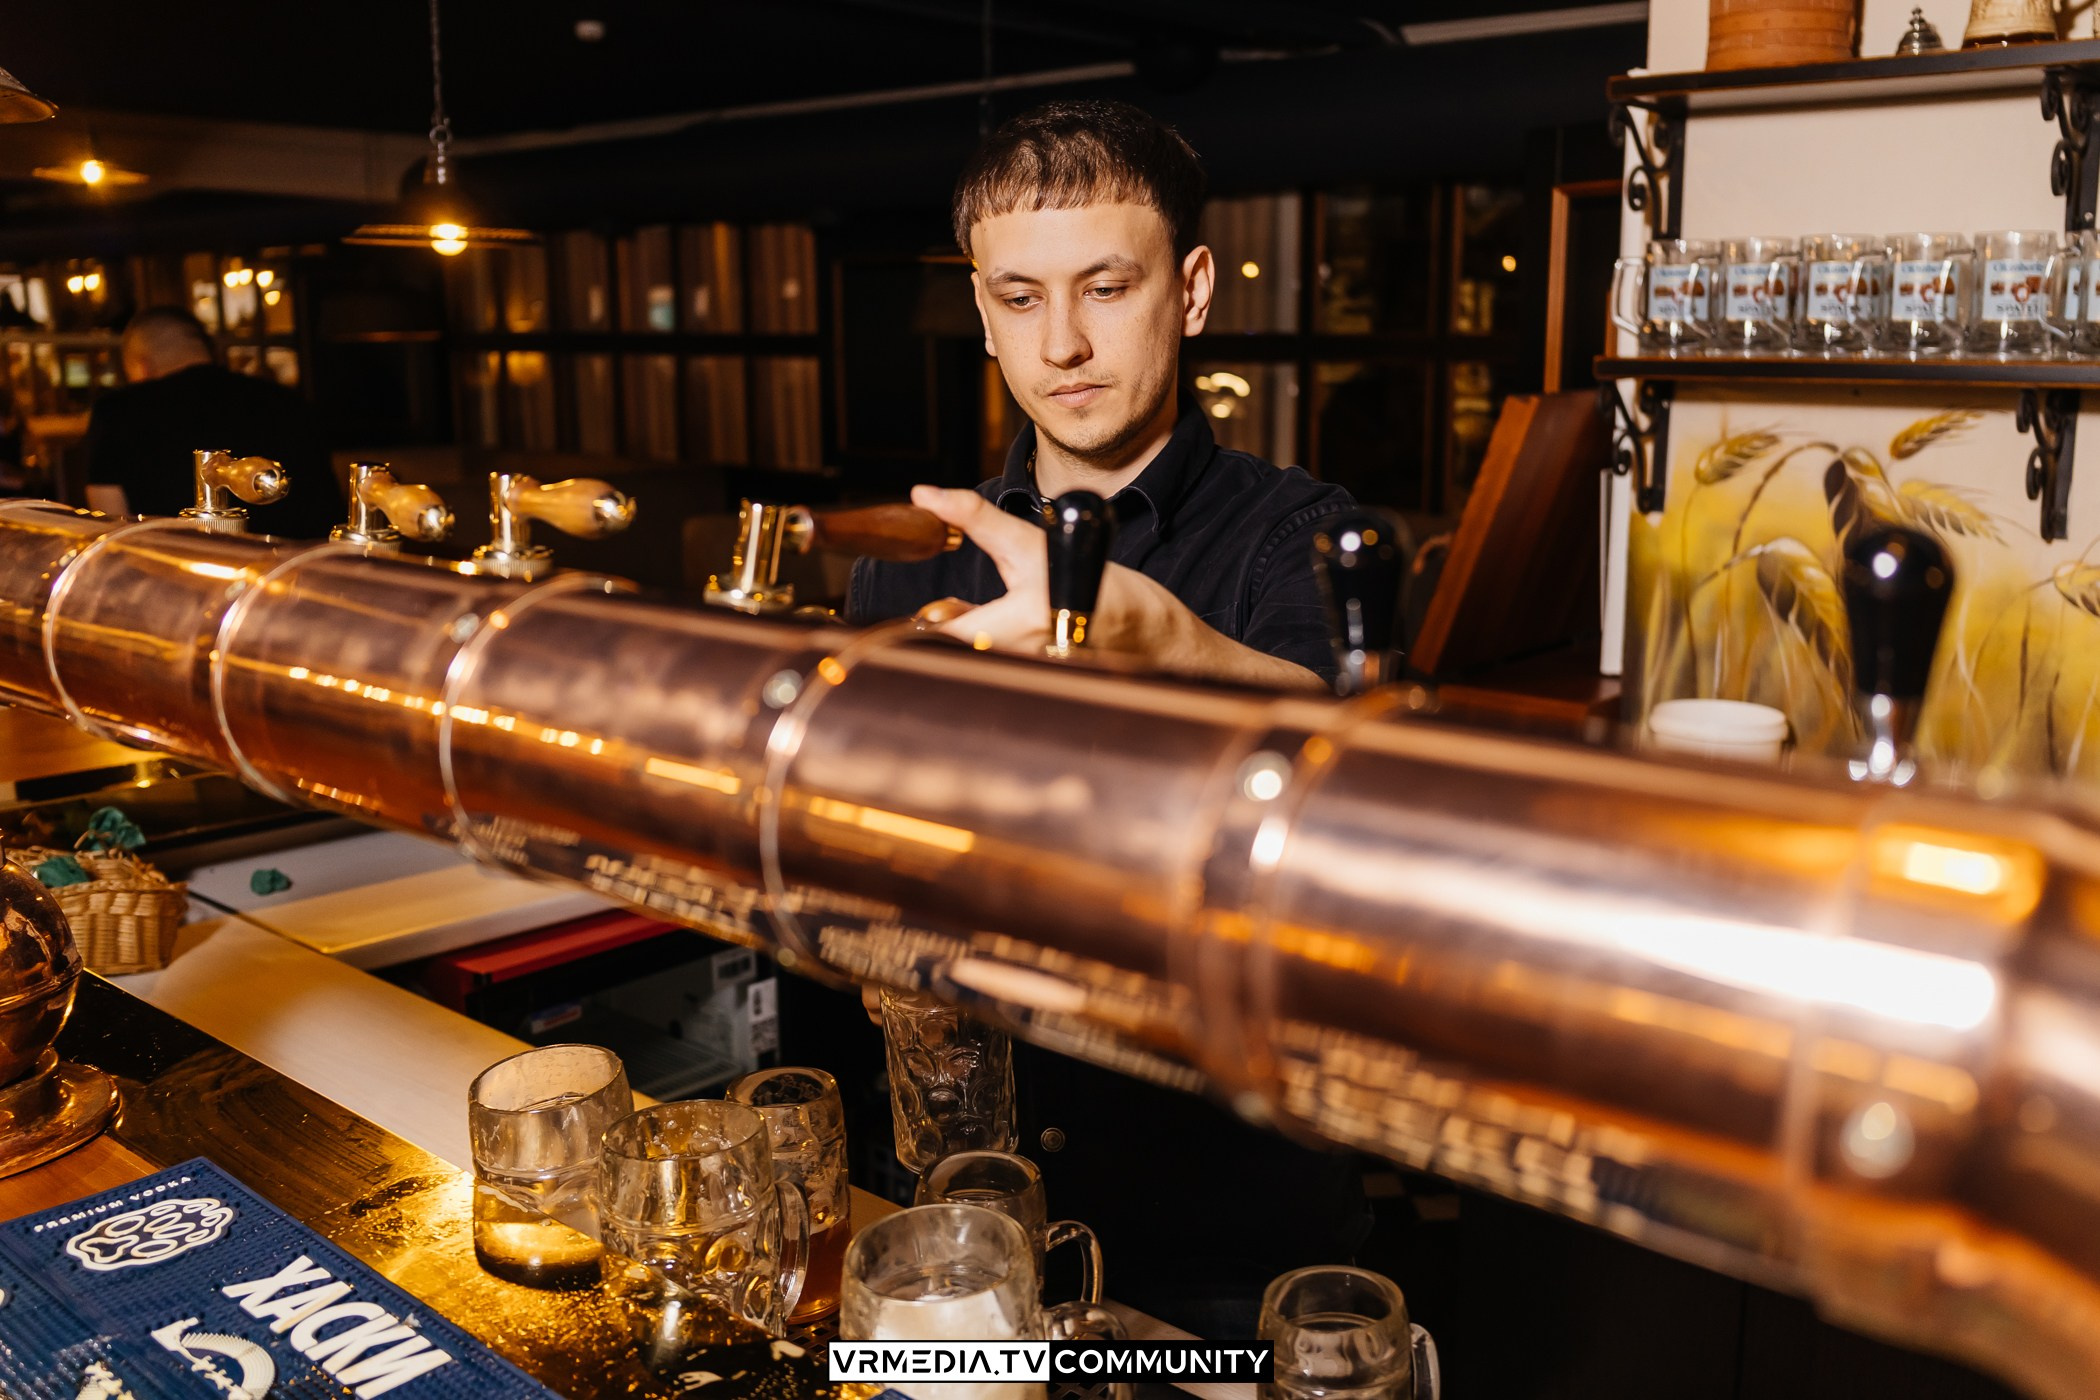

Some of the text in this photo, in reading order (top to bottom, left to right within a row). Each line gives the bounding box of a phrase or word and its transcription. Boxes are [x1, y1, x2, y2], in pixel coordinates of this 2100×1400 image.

[34, 1176, 191, 1232] PREMIUM VODKA
[222, 1255, 452, 1400] ХАСКИ
